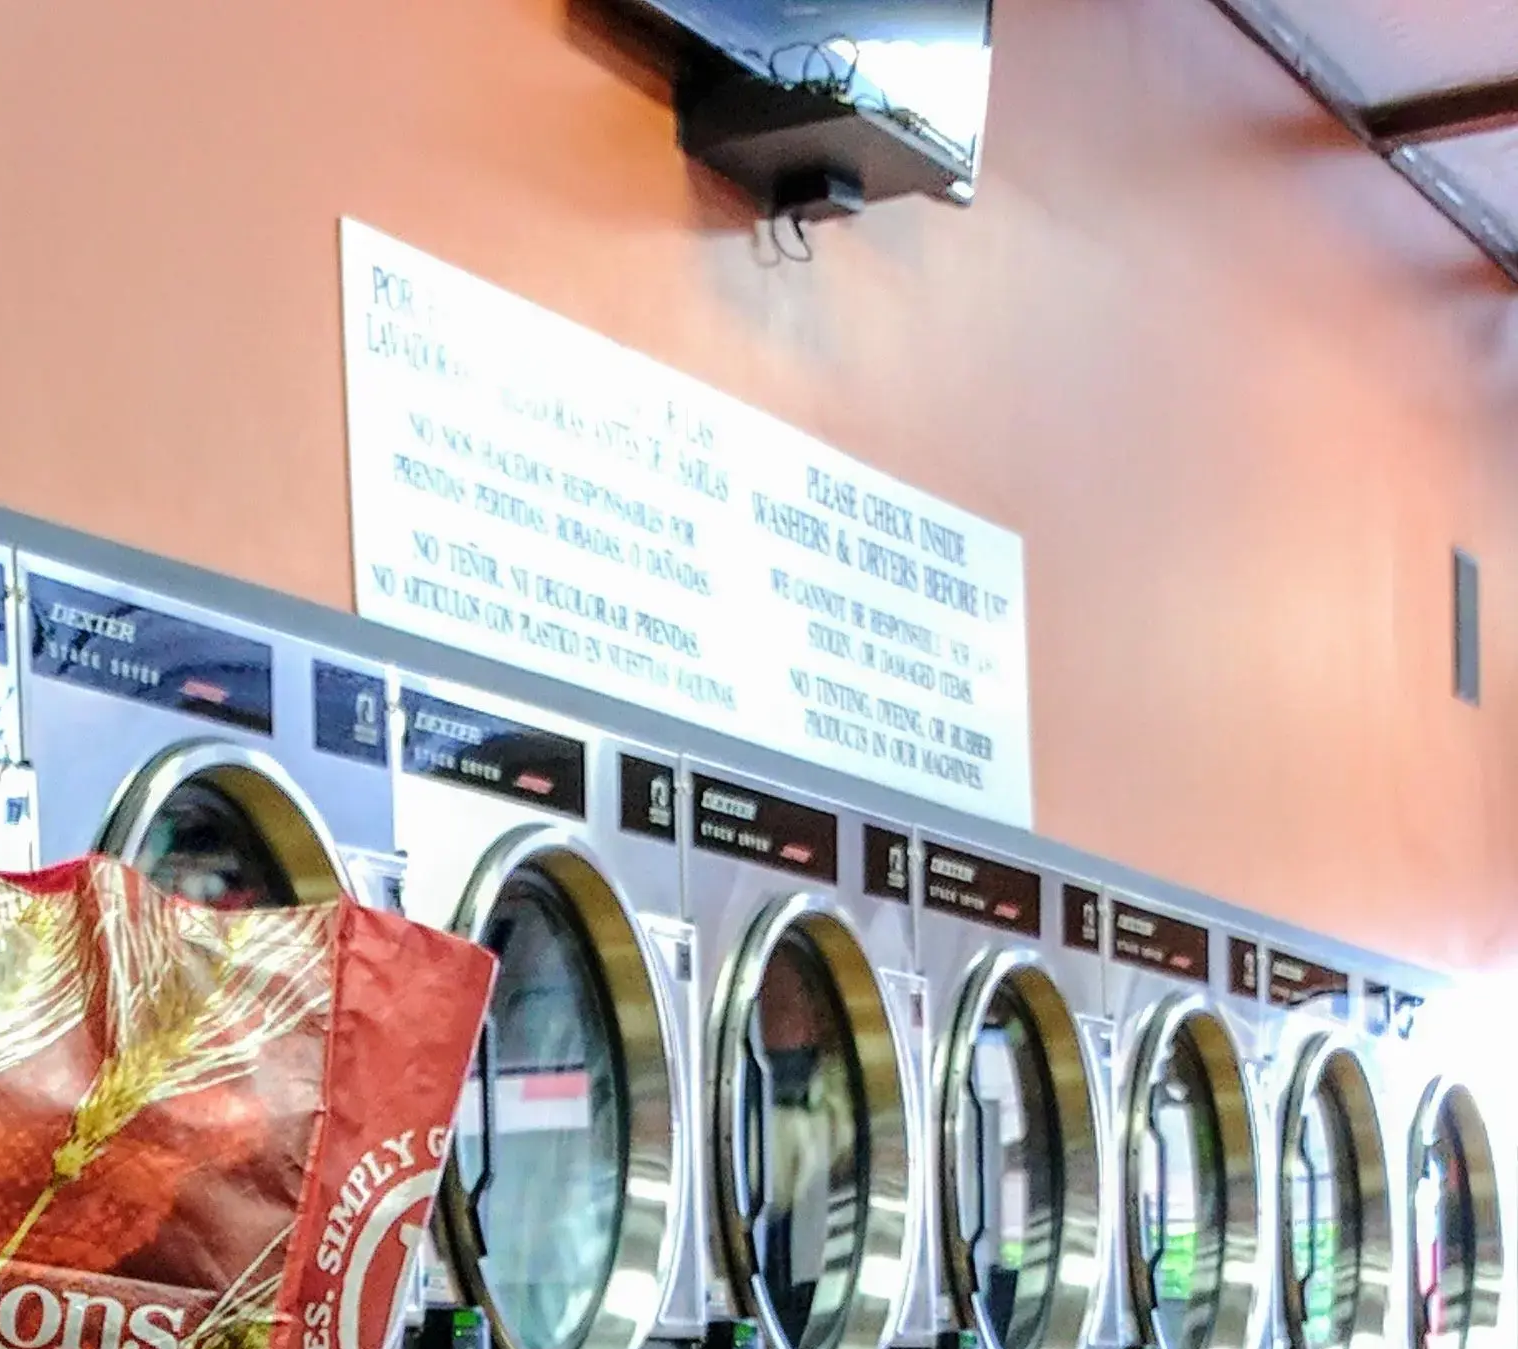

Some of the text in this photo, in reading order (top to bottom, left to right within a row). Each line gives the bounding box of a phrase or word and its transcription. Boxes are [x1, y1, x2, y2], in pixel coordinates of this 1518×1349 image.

[806, 464, 967, 568] PLEASE CHECK INSIDE
[412, 528, 439, 567] NO
[752, 489, 830, 557] WASHERS
[836, 525, 851, 566] &
[858, 535, 917, 593] DRYERS
[923, 563, 979, 619] BEFORE
[370, 561, 394, 598] NO
[770, 566, 789, 600] WE
[793, 575, 846, 622] CANNOT
[50, 603, 135, 643] DEXTER
[880, 646, 935, 692] DAMAGED
[789, 666, 809, 699] NO
[928, 716, 945, 746] OR
[950, 723, 992, 762] RUBBER
[803, 706, 867, 753] PRODUCTS
[871, 729, 887, 760] IN
[889, 735, 917, 770] OUR
[317, 1129, 415, 1276] SIMPLY
